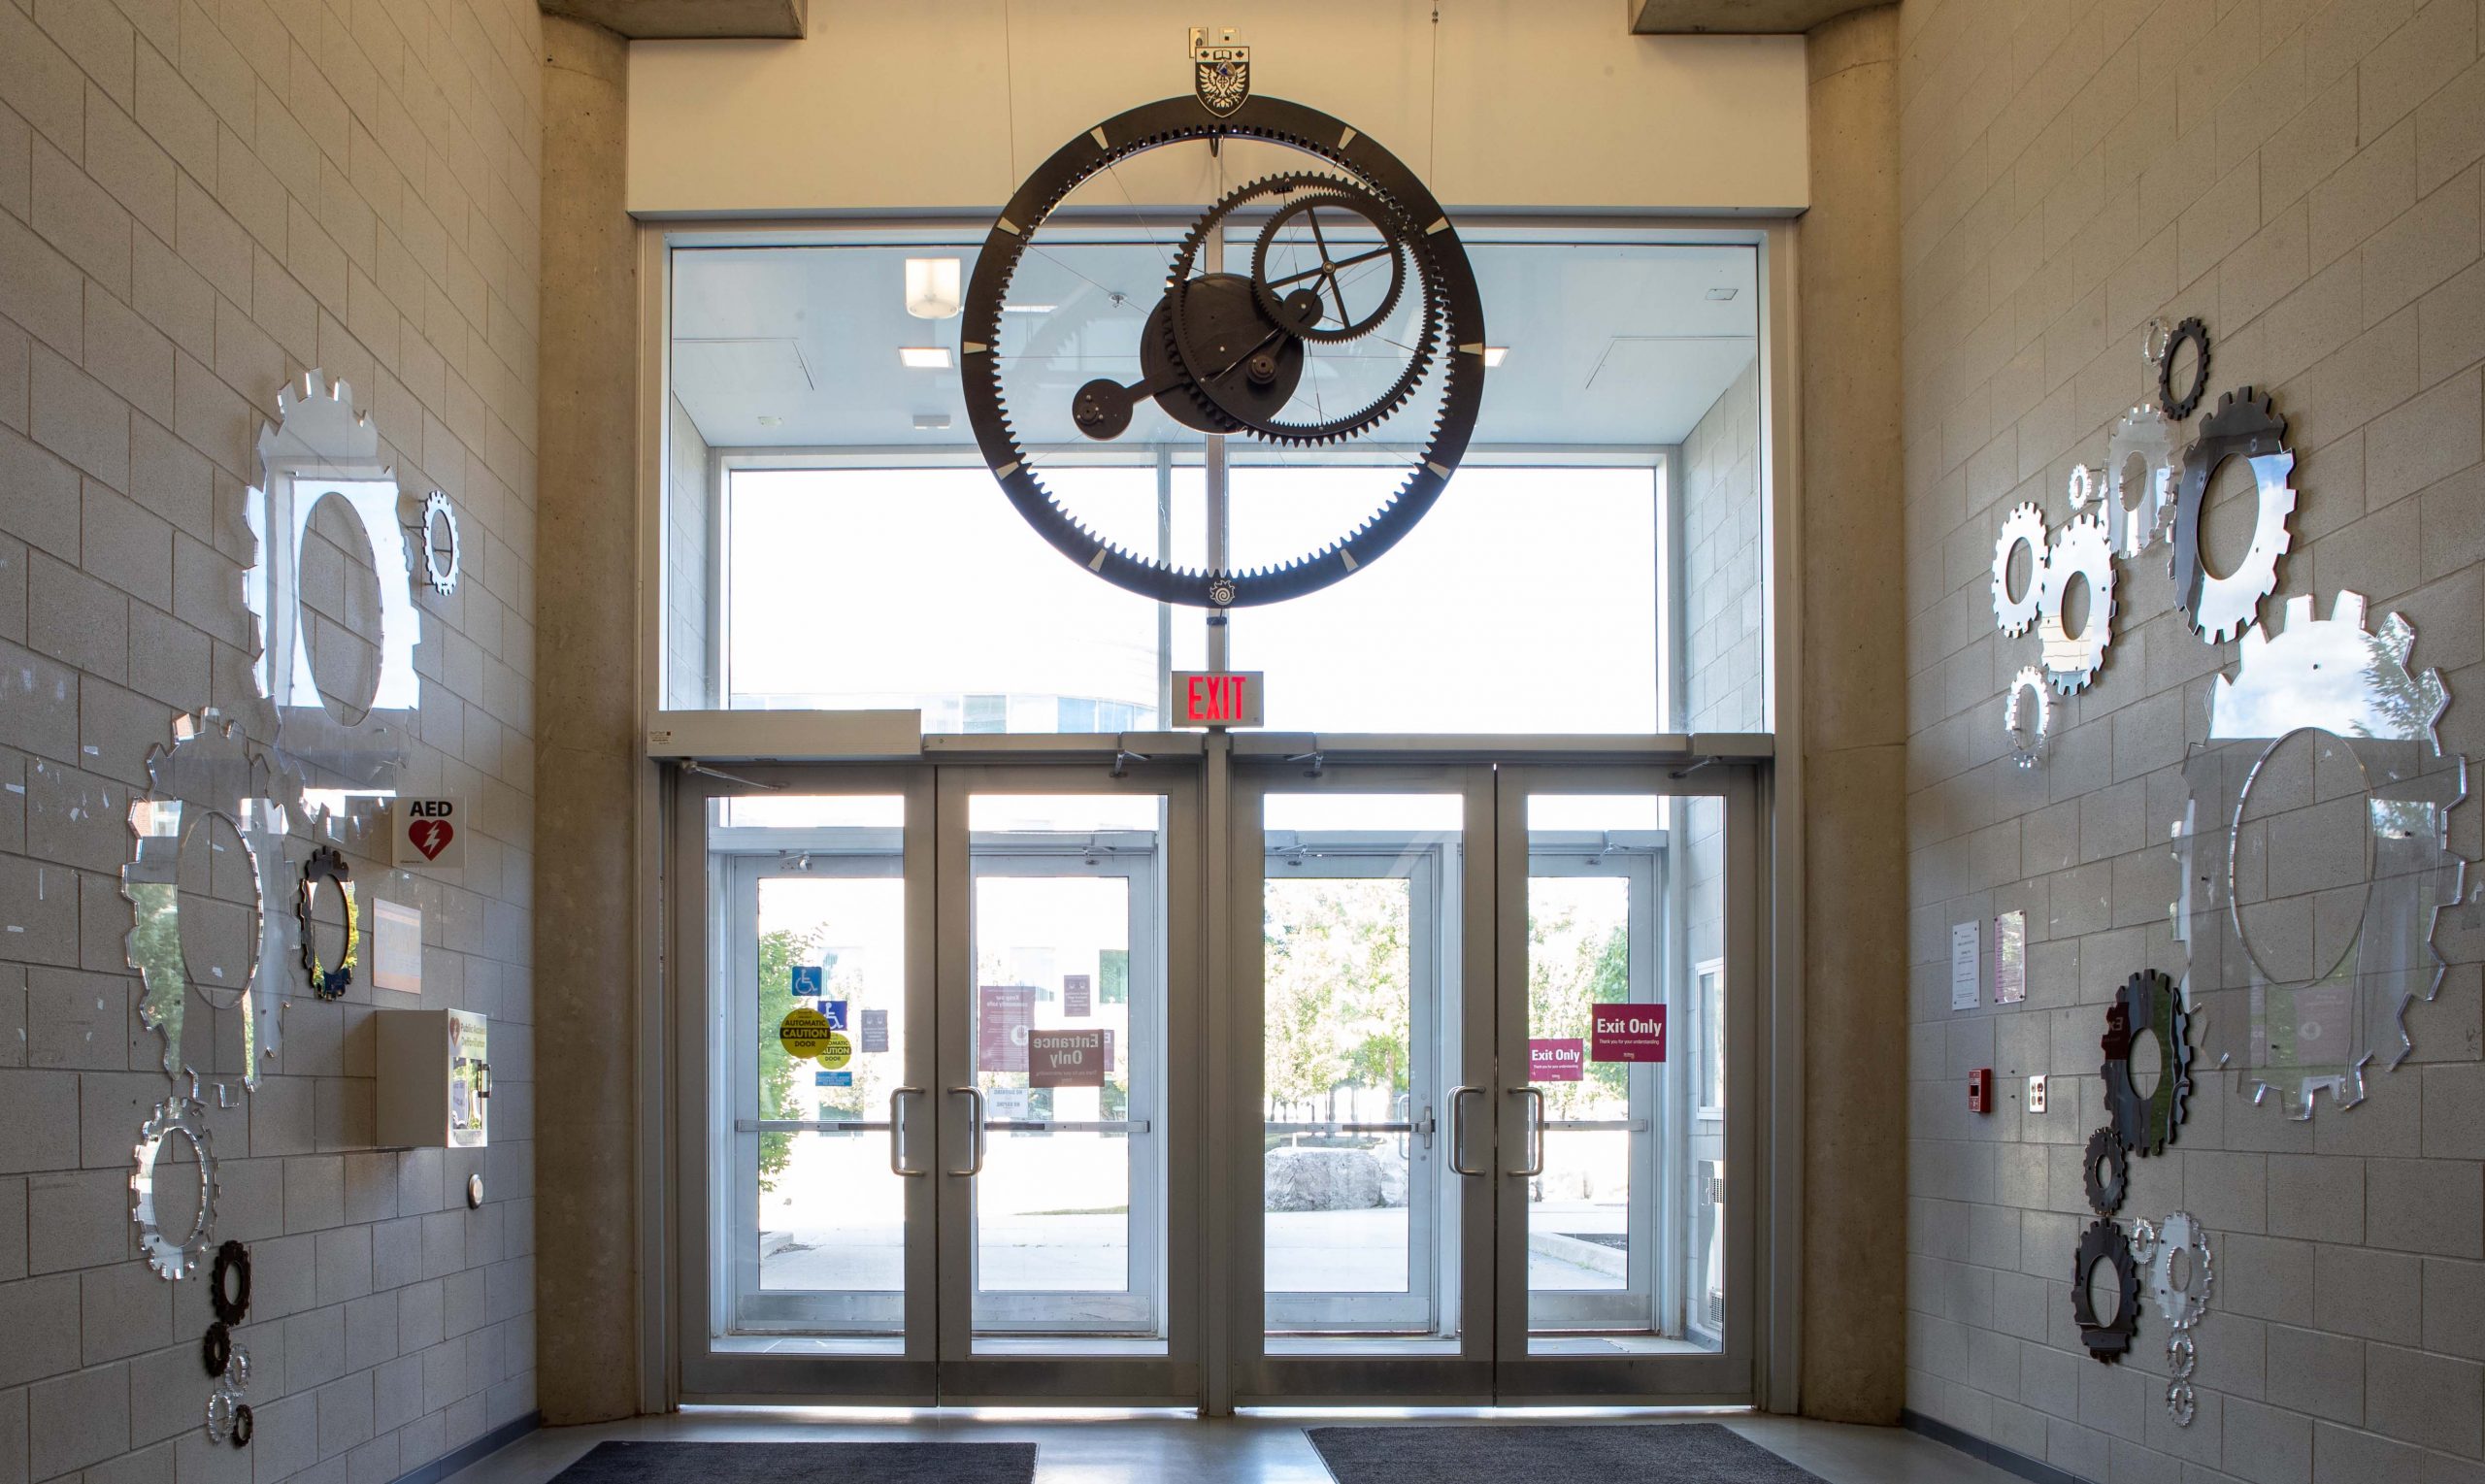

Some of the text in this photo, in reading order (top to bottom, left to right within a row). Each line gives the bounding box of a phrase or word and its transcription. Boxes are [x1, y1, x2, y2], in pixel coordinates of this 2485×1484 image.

[1187, 676, 1246, 721] EXIT
[410, 801, 453, 817] AED
[782, 1029, 828, 1039] CAUTION
[1597, 1018, 1662, 1038] Exit Only
[1531, 1048, 1580, 1064] Exit Only
